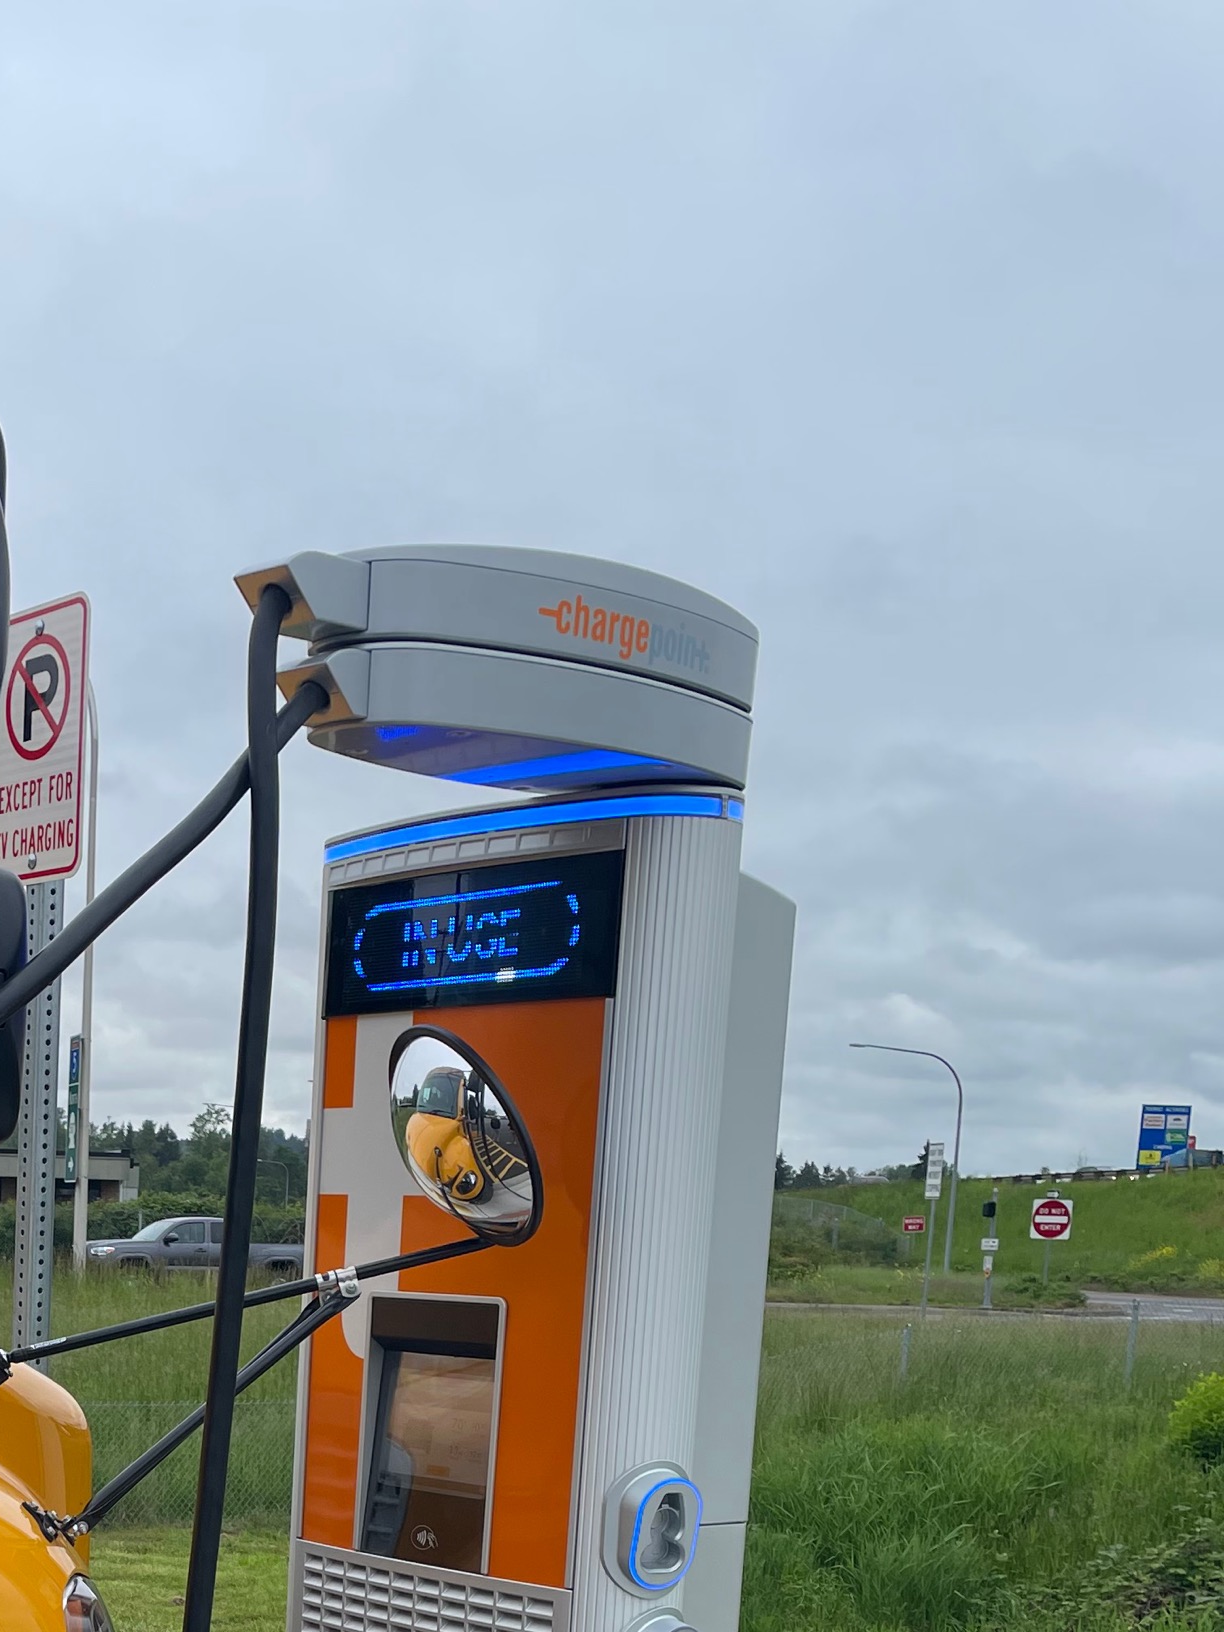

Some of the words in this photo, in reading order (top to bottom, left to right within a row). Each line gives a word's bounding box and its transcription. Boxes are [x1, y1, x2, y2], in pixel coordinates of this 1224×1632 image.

[48, 771, 73, 804] FOR
[12, 818, 74, 857] CHARGING
[1038, 1207, 1050, 1215] DO
